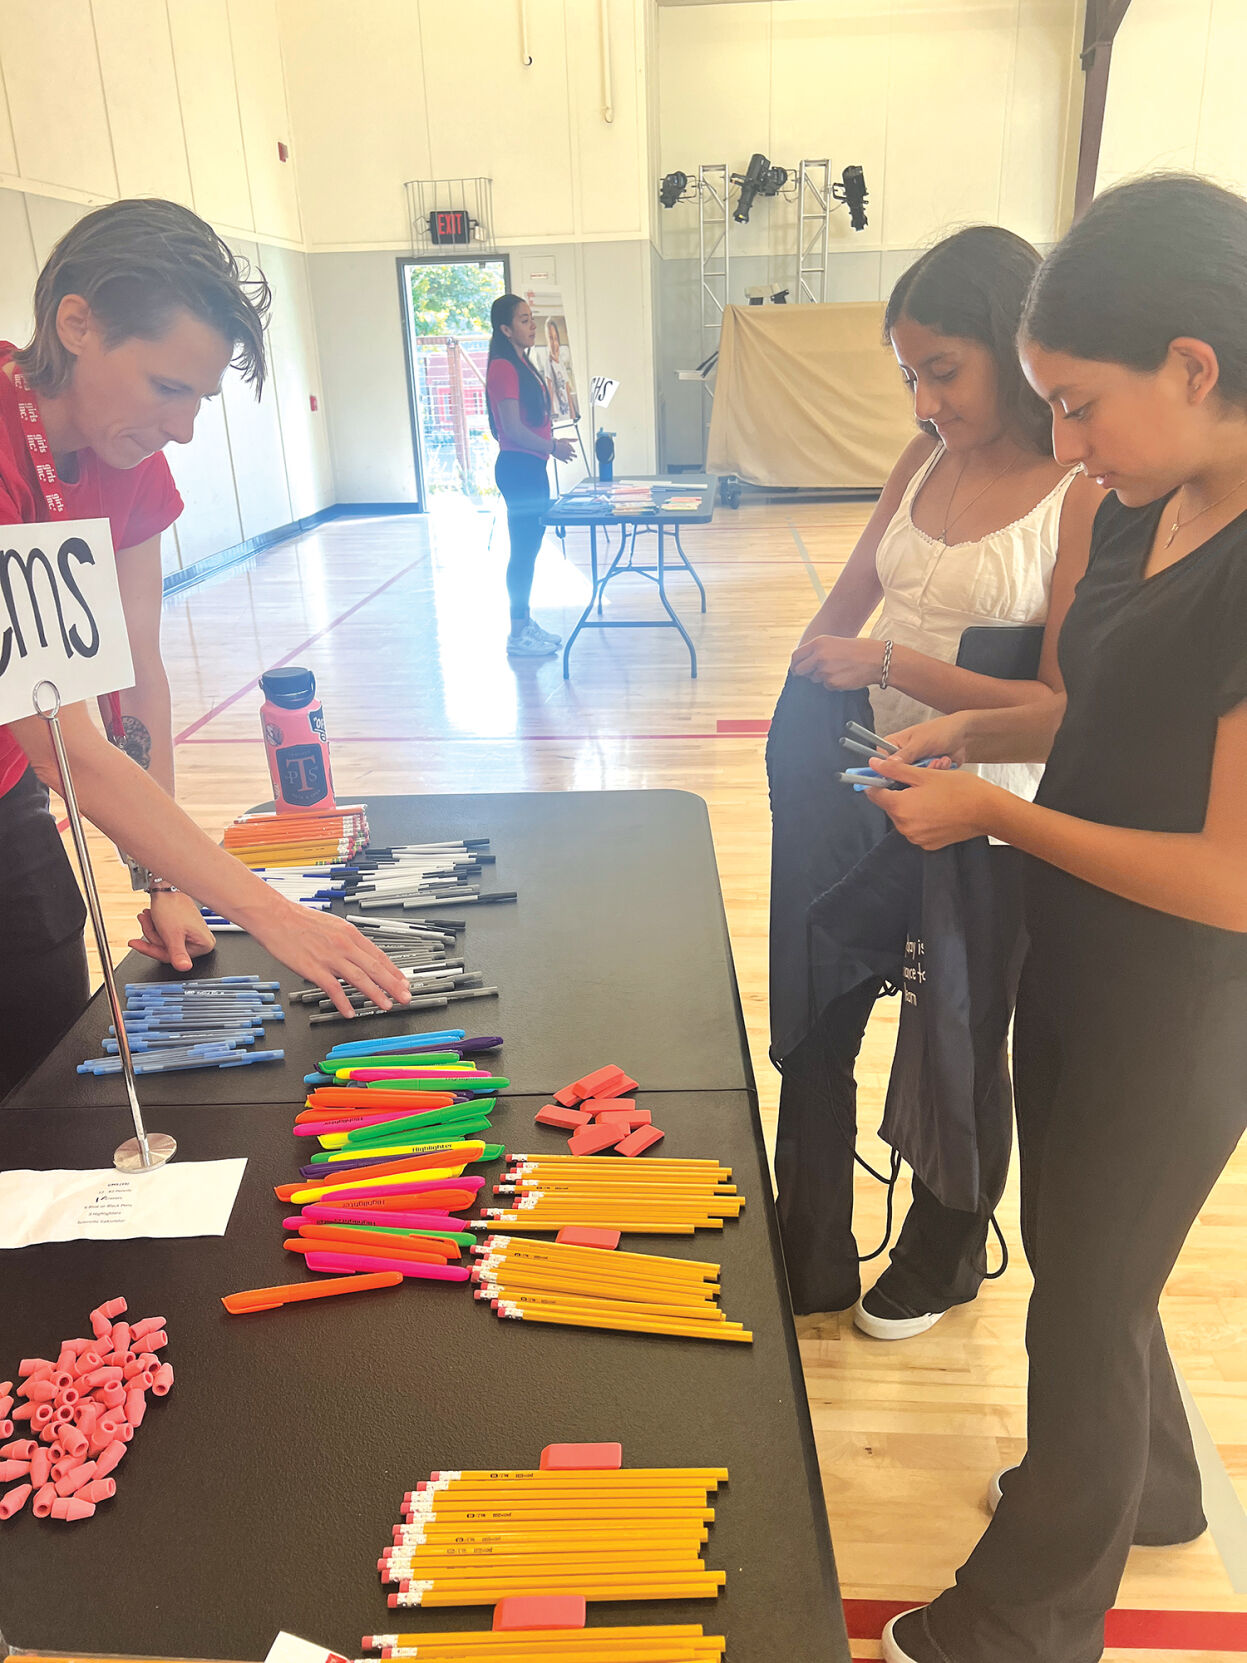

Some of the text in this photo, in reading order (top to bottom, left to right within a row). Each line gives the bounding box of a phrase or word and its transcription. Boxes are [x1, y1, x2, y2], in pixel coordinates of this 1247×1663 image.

[437, 213, 462, 235] EXIT
[26, 402, 38, 423] girls
[34, 434, 47, 453] girls
[43, 463, 56, 483] girls
[52, 493, 64, 512] girls
[412, 1144, 452, 1153] Highlighter
